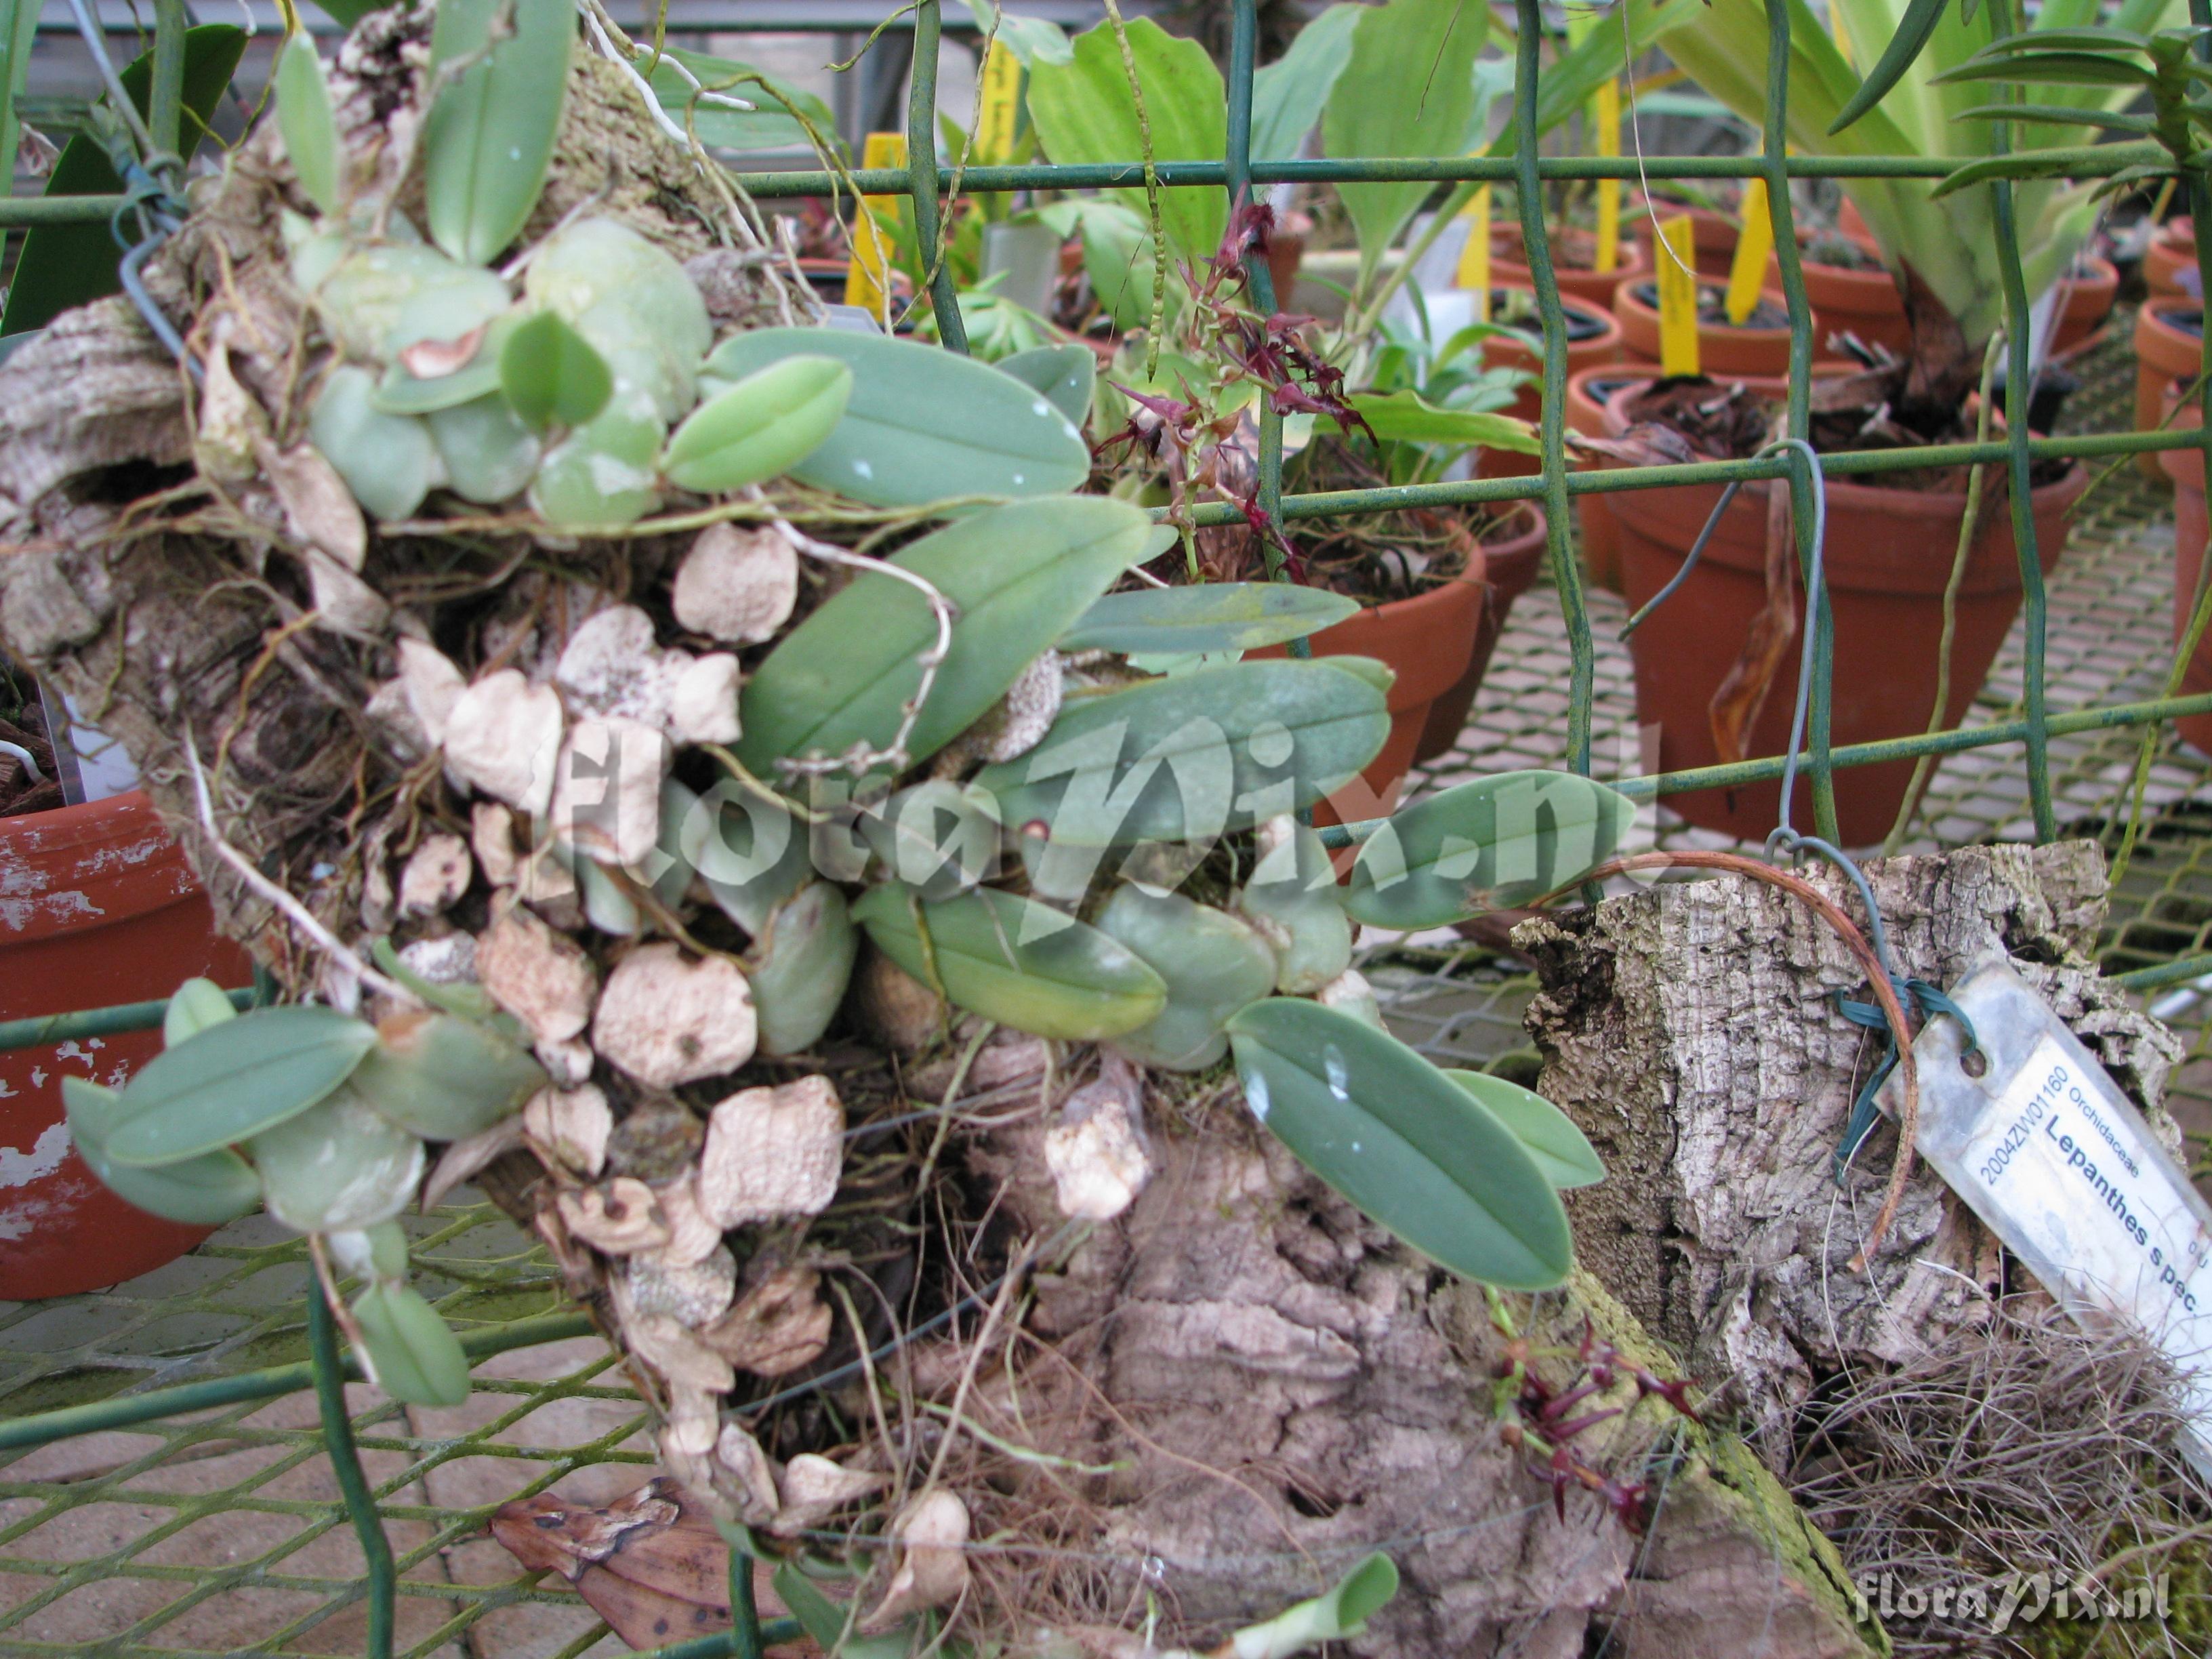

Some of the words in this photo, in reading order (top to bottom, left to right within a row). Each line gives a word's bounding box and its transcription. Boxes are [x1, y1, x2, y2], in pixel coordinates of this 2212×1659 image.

[1980, 1065, 2069, 1187] 2004ZW01160
[2045, 1114, 2148, 1246] Lepanthes
[2068, 1086, 2139, 1179] Orchidaceae
